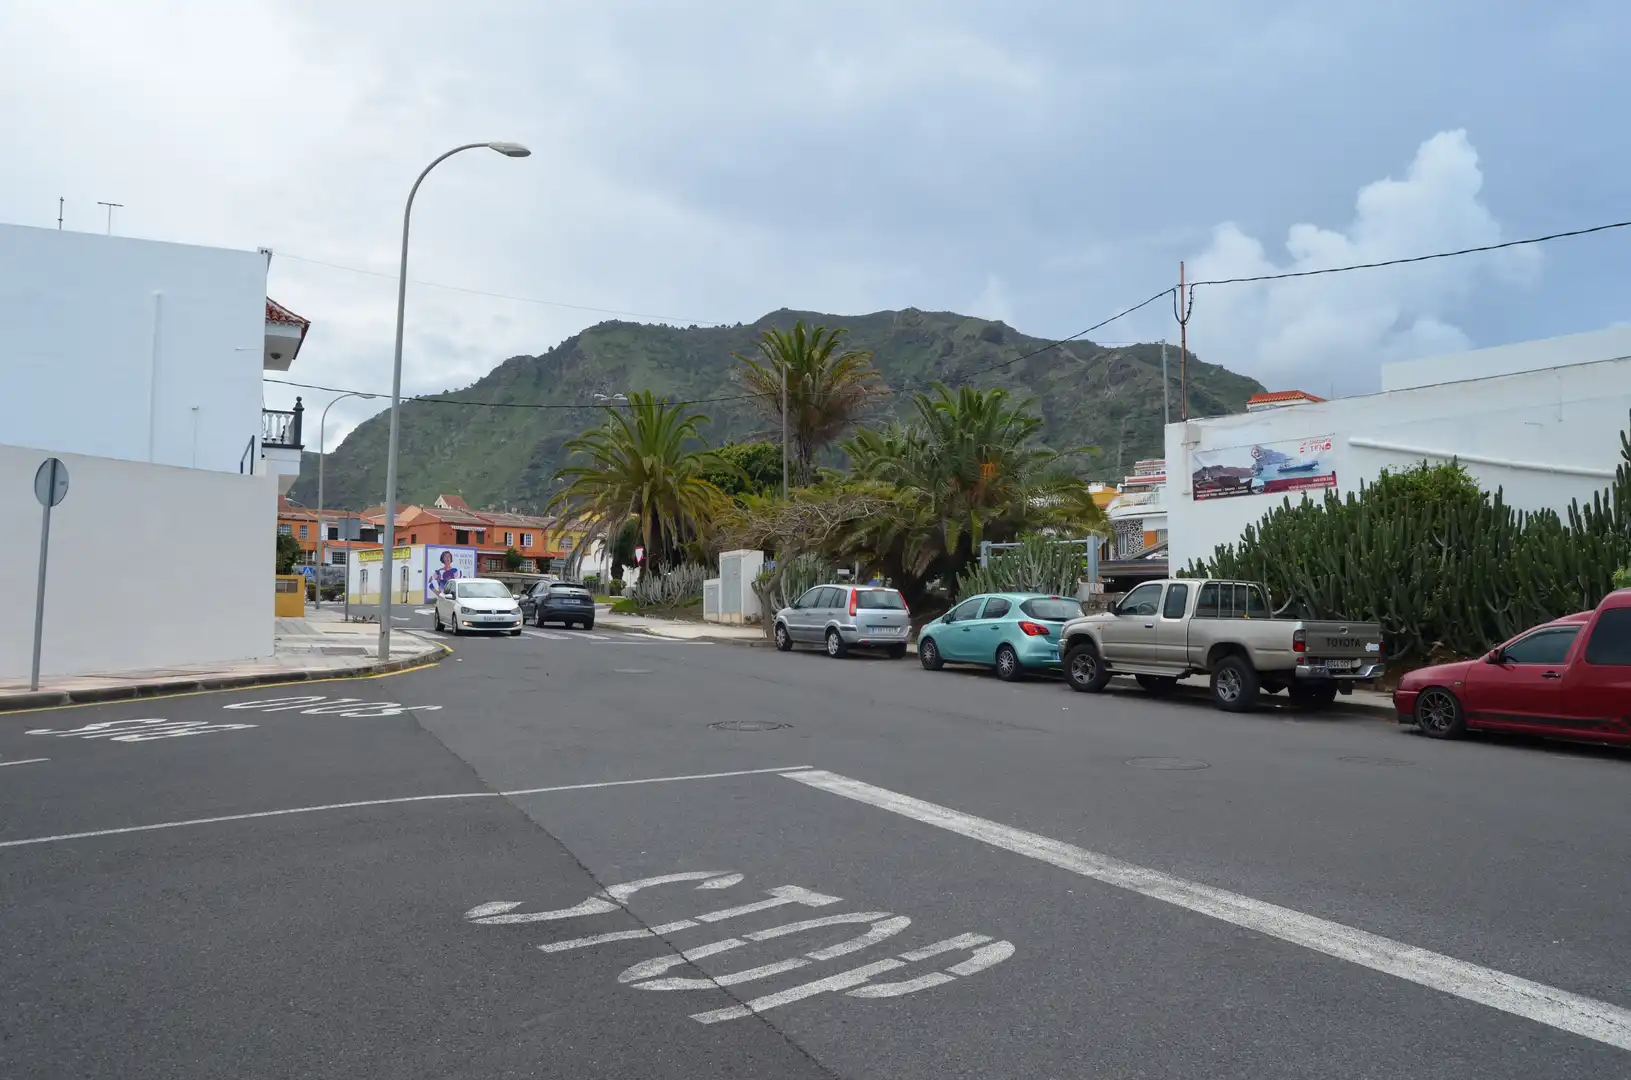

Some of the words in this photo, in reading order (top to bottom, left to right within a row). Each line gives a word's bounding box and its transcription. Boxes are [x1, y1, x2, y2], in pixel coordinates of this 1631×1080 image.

[1310, 443, 1331, 452] TENO
[1326, 638, 1360, 647] TOYOTA
[223, 696, 442, 717] SOLO
[25, 718, 259, 742] BUS
[464, 870, 1016, 1024] STOP
